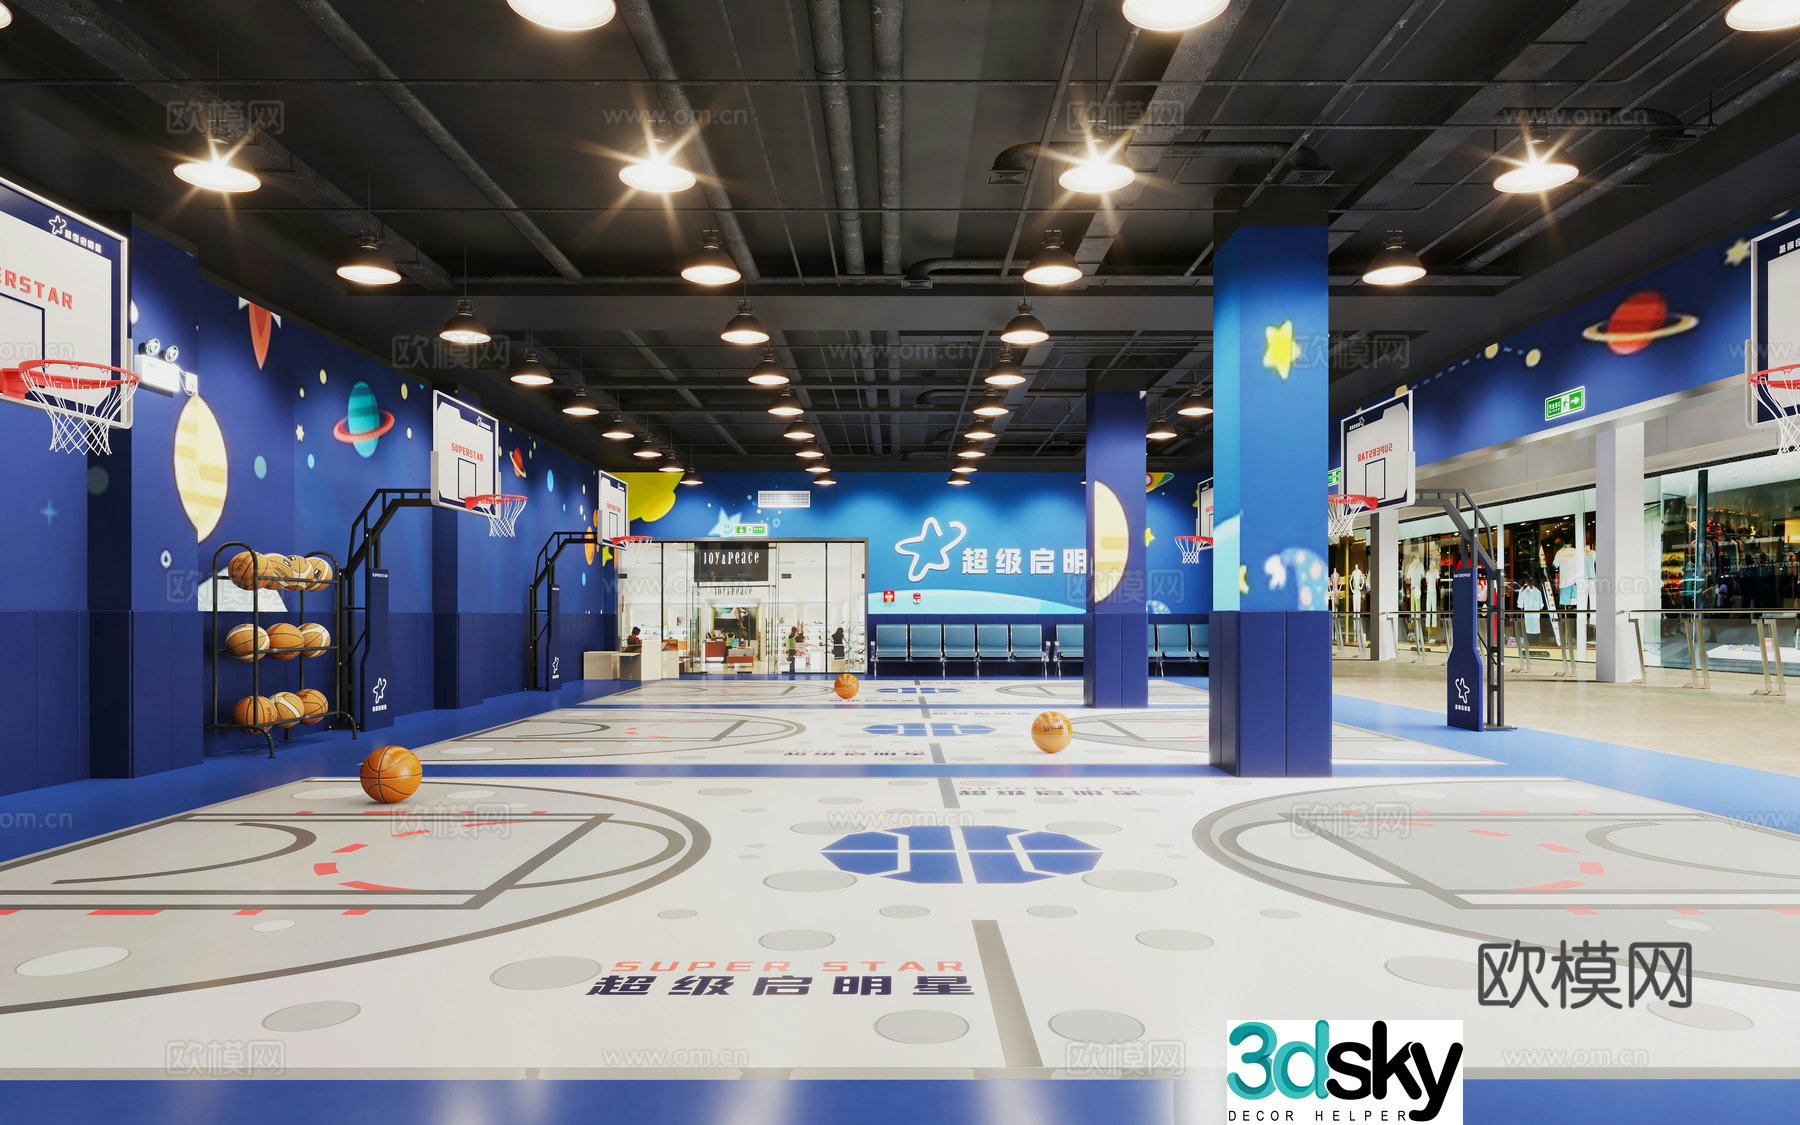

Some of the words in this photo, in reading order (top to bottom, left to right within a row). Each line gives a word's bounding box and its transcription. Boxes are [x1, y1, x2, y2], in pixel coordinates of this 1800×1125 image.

[451, 442, 484, 462] SUPERSTAR
[611, 961, 792, 973] SUPER
[822, 961, 965, 973] STAR
[585, 975, 976, 996] 超级启明星
